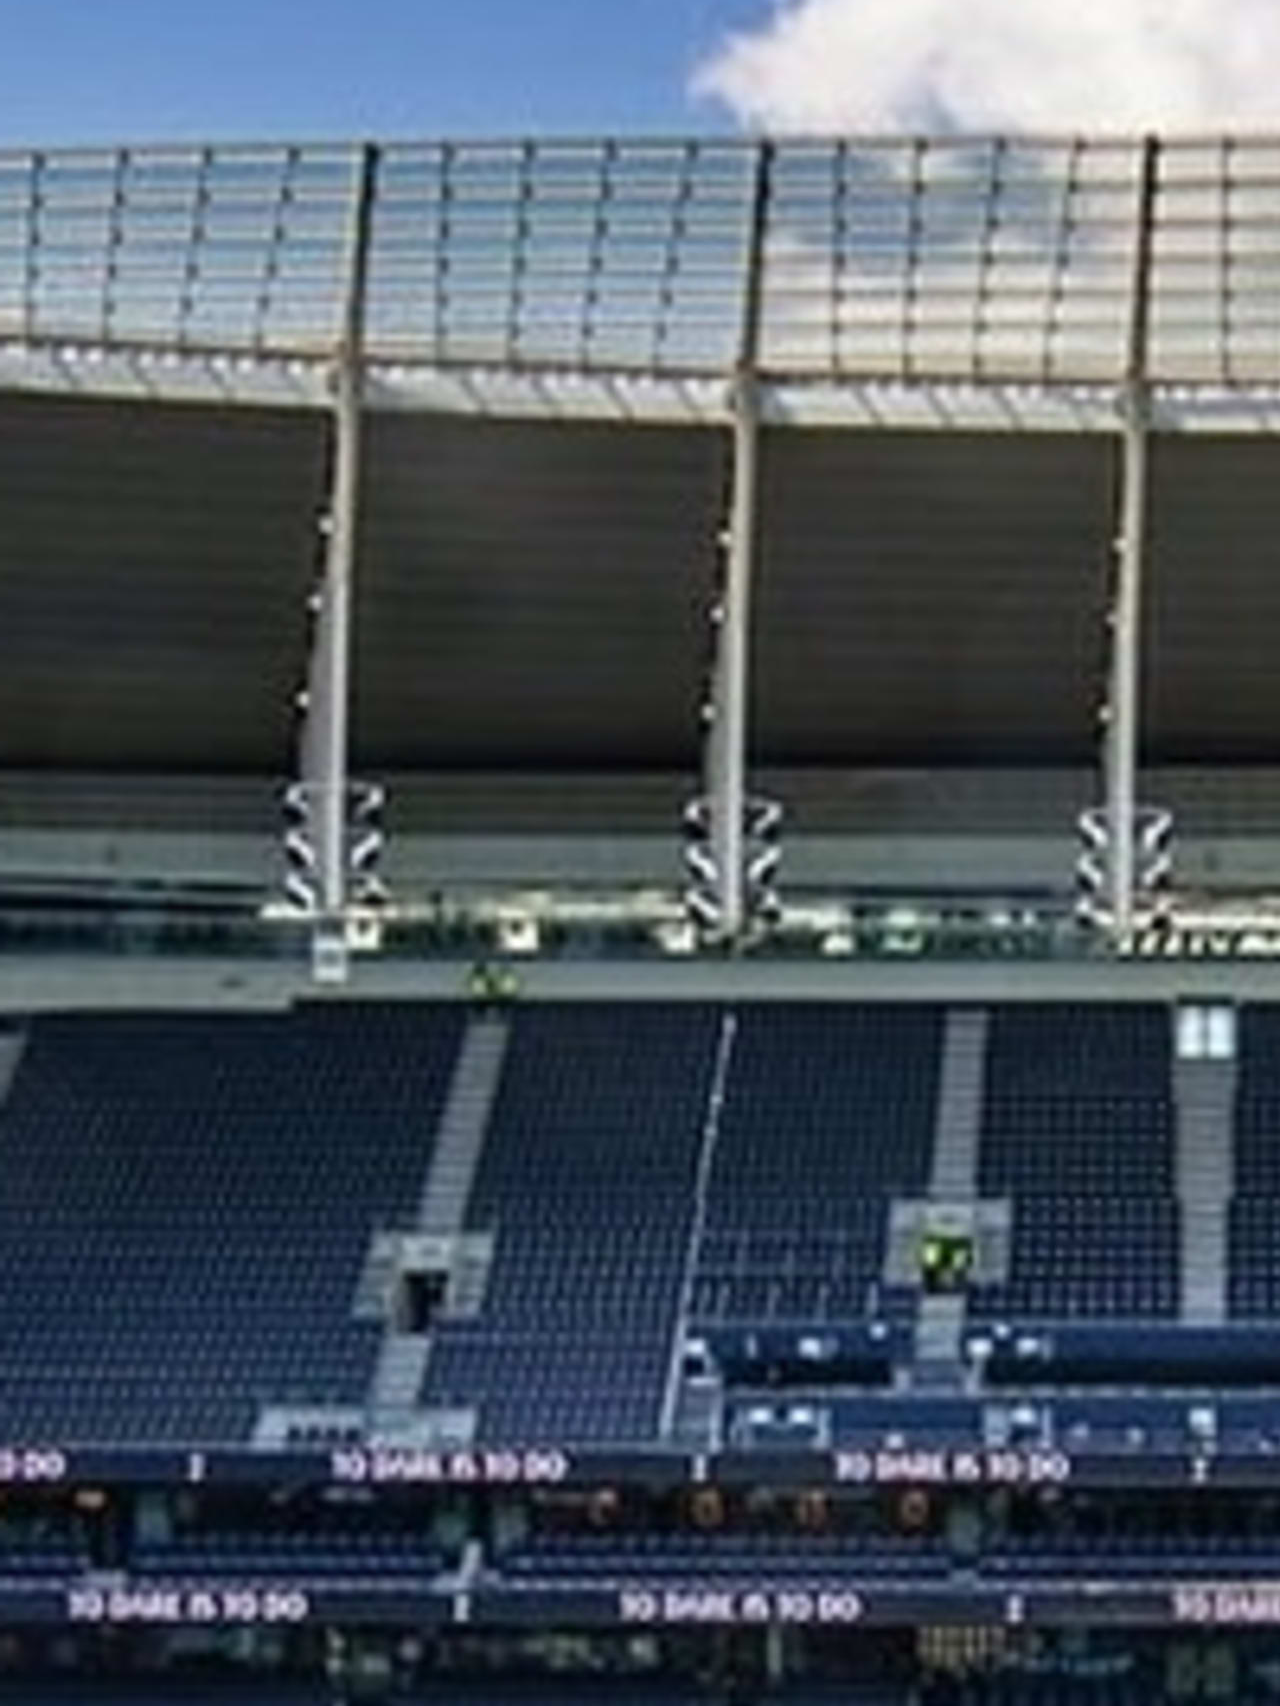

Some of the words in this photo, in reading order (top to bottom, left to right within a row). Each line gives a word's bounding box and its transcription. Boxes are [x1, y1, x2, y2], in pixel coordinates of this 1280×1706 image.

[24, 1451, 66, 1481] DO
[331, 1451, 367, 1481] TO
[484, 1451, 519, 1481] TO
[523, 1451, 569, 1481] DO
[836, 1453, 871, 1483] TO
[988, 1453, 1021, 1483] TO
[1028, 1453, 1070, 1483] DO
[68, 1591, 104, 1621] TO
[222, 1591, 258, 1621] TO
[262, 1591, 309, 1621] DO
[620, 1591, 656, 1621] TO
[776, 1591, 814, 1621] TO
[817, 1591, 861, 1621] DO
[1175, 1593, 1211, 1623] TO
